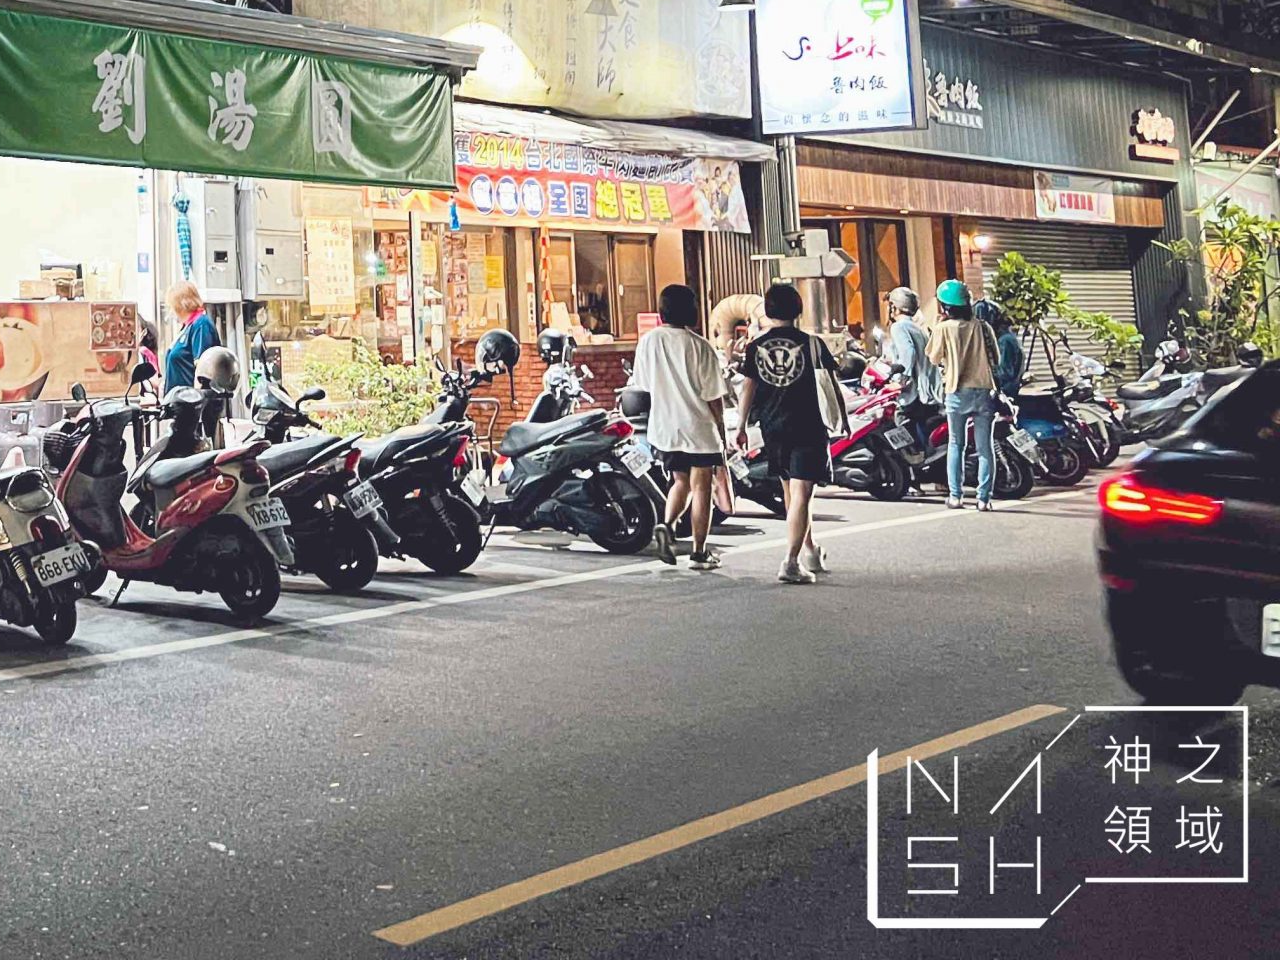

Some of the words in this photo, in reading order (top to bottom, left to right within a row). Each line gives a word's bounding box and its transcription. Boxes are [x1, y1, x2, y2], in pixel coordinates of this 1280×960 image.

[830, 74, 888, 96] 魯肉飯
[91, 47, 354, 154] 劉湯圓
[38, 551, 87, 581] 868-EKU
